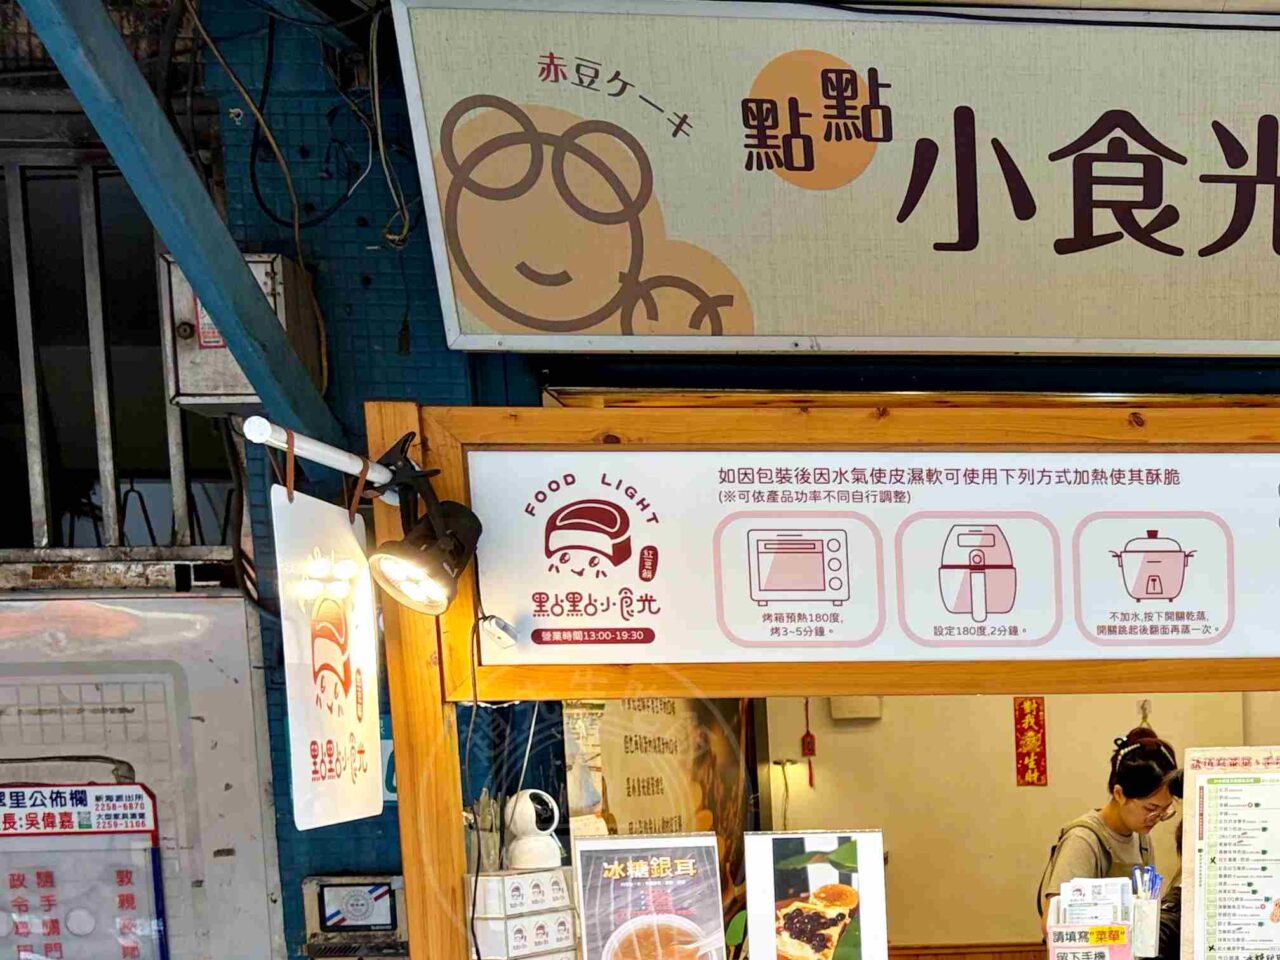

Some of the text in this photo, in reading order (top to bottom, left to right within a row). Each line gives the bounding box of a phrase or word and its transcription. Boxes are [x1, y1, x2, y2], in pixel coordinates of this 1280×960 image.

[537, 51, 693, 141] 赤豆ケーキ
[524, 473, 660, 525] FOOD LIGHT
[532, 587, 661, 621] 點點小食光
[0, 812, 74, 831] 長:吳偉嘉
[602, 857, 697, 880] 冰糖銀耳
